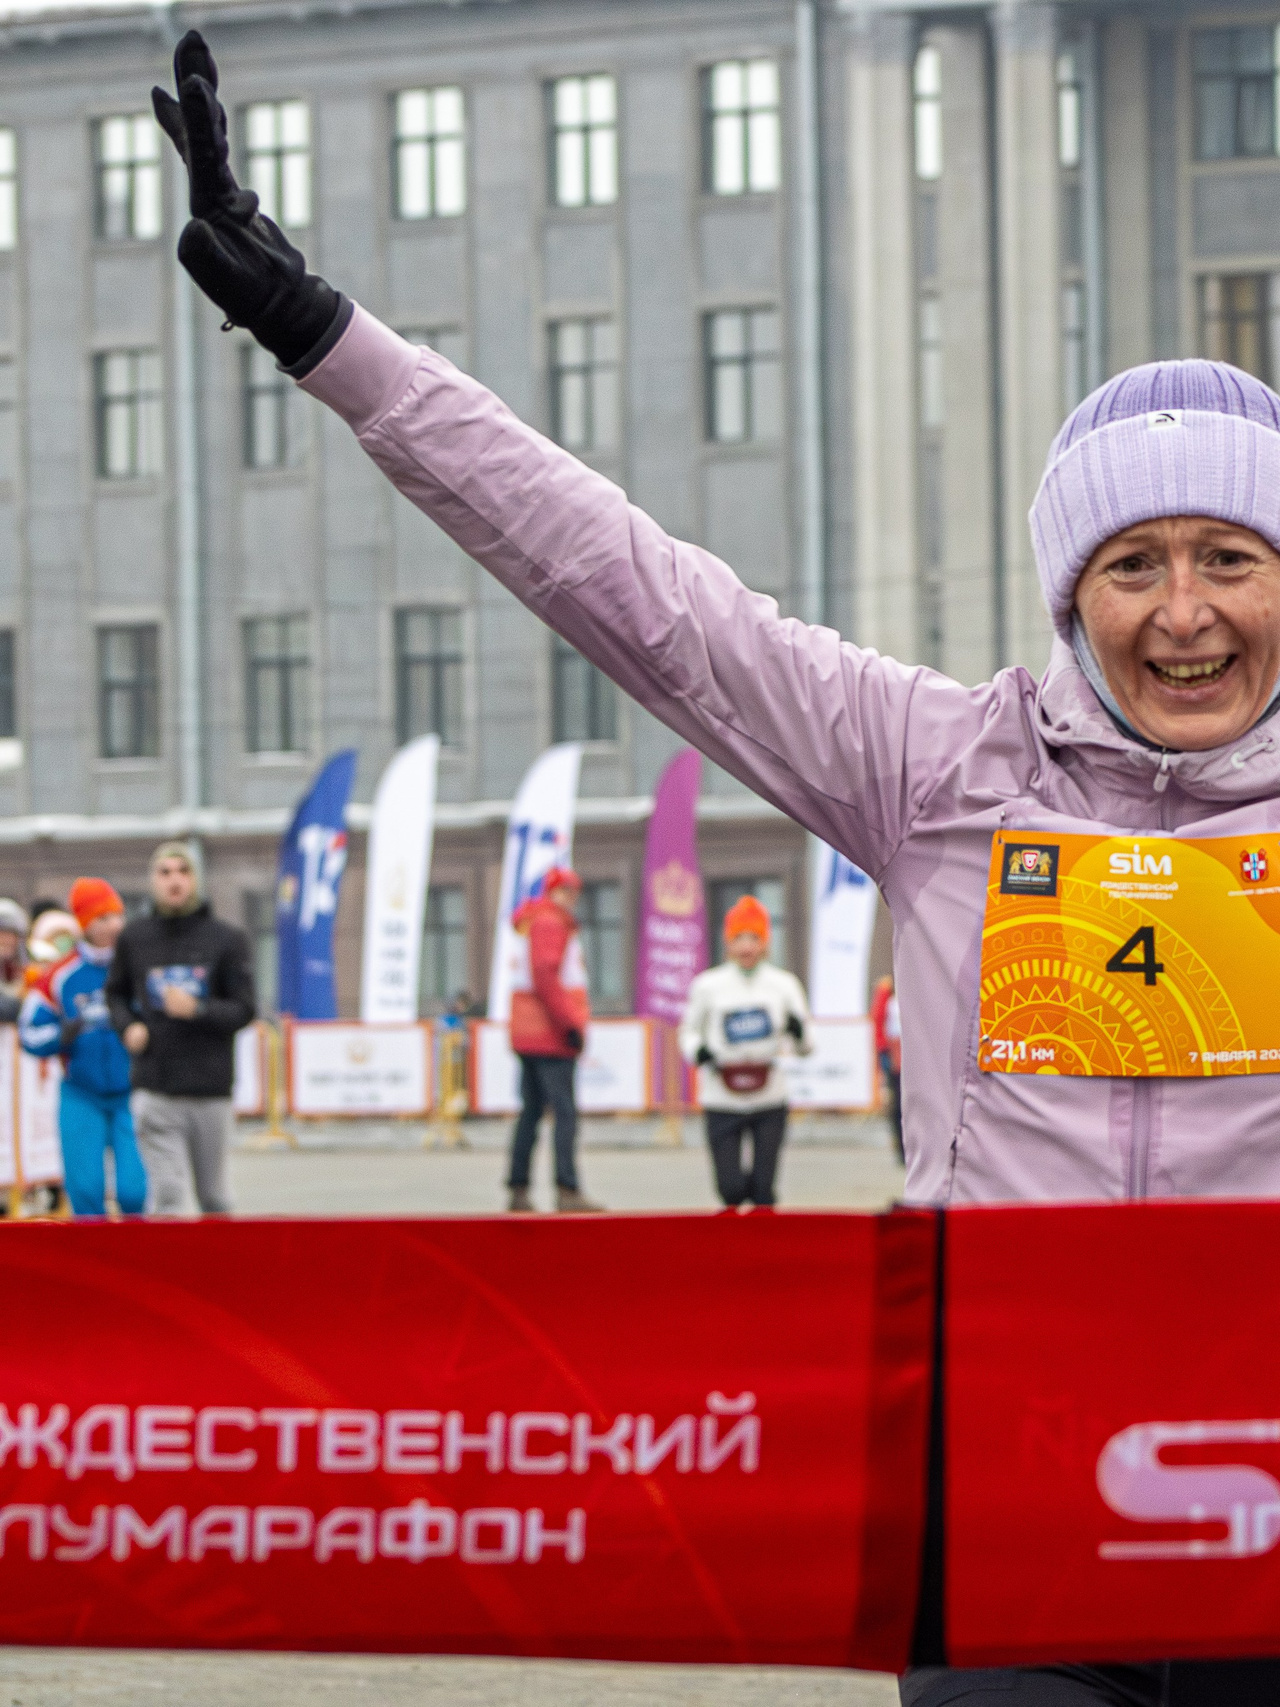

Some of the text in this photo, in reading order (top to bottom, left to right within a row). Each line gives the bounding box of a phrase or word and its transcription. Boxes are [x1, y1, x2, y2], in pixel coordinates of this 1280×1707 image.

[1105, 926, 1164, 986] 4
[991, 1039, 1026, 1062] 21,1
[1188, 1051, 1199, 1063] 7
[0, 1391, 762, 1482] ЖДЕСТВЕНСКИЙ
